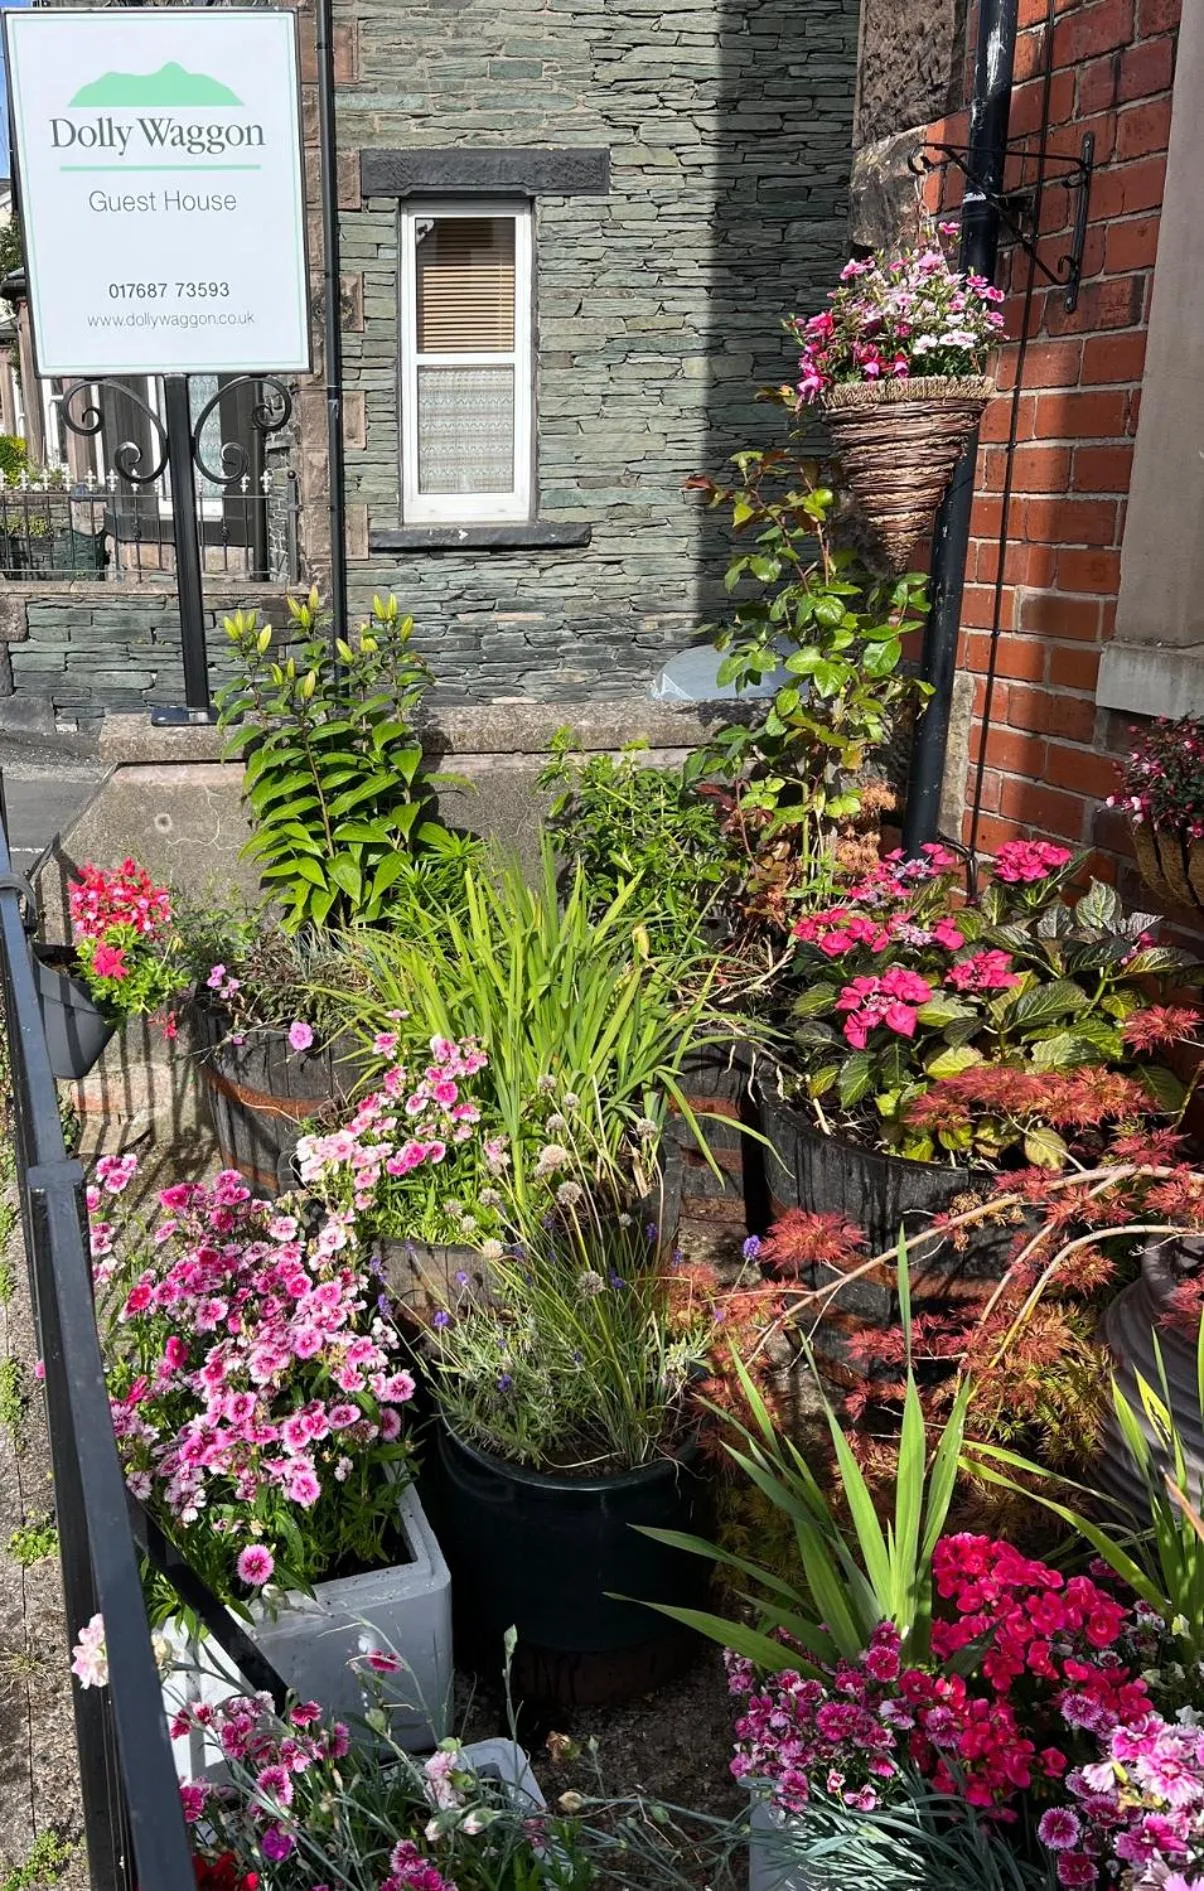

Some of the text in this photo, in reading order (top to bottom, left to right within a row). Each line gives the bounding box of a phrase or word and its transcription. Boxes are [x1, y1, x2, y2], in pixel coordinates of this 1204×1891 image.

[49, 116, 266, 156] Dolly Waggon
[88, 190, 237, 213] Guest House
[109, 282, 230, 299] 017687 73593
[87, 311, 255, 329] www.dollywaggon.co.uk
